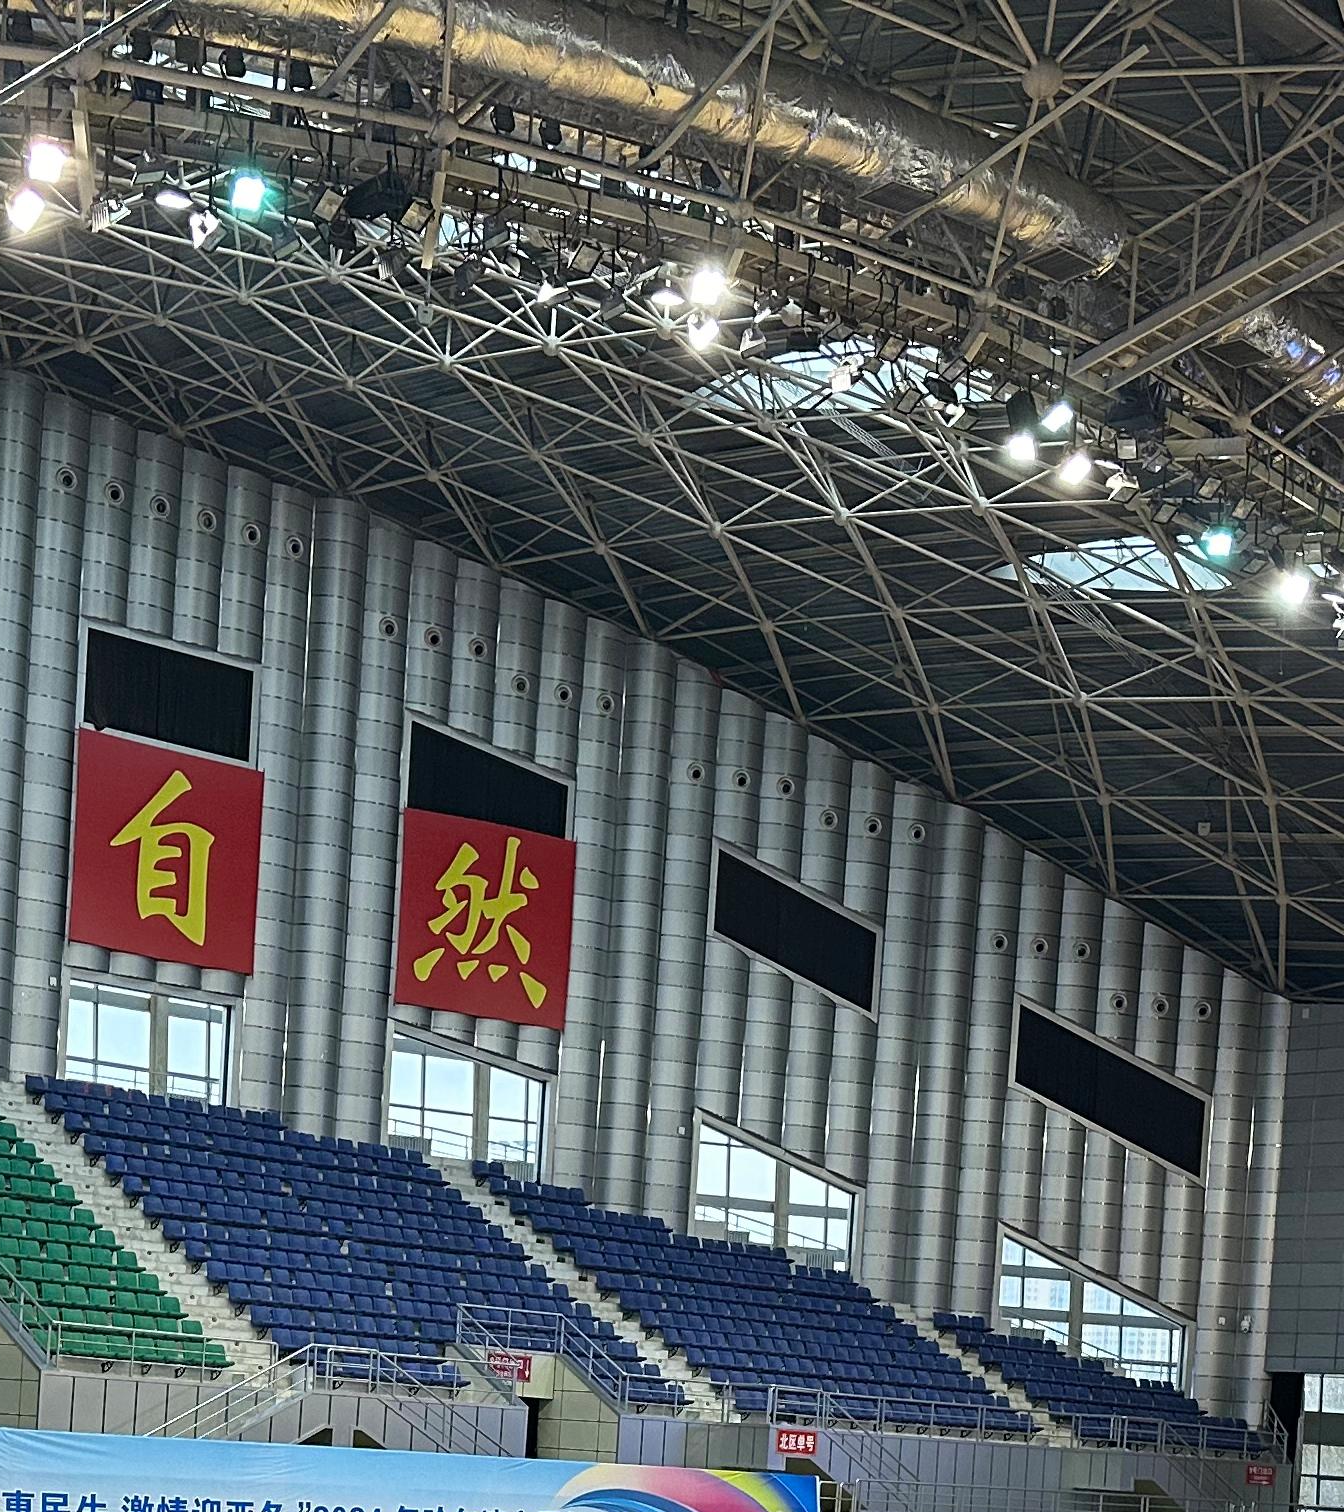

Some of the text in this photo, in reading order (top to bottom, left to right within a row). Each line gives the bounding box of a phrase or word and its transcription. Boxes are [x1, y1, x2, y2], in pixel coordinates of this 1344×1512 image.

[110, 769, 216, 947] 自
[413, 835, 548, 1009] 然
[779, 1433, 814, 1451] 北区单号
